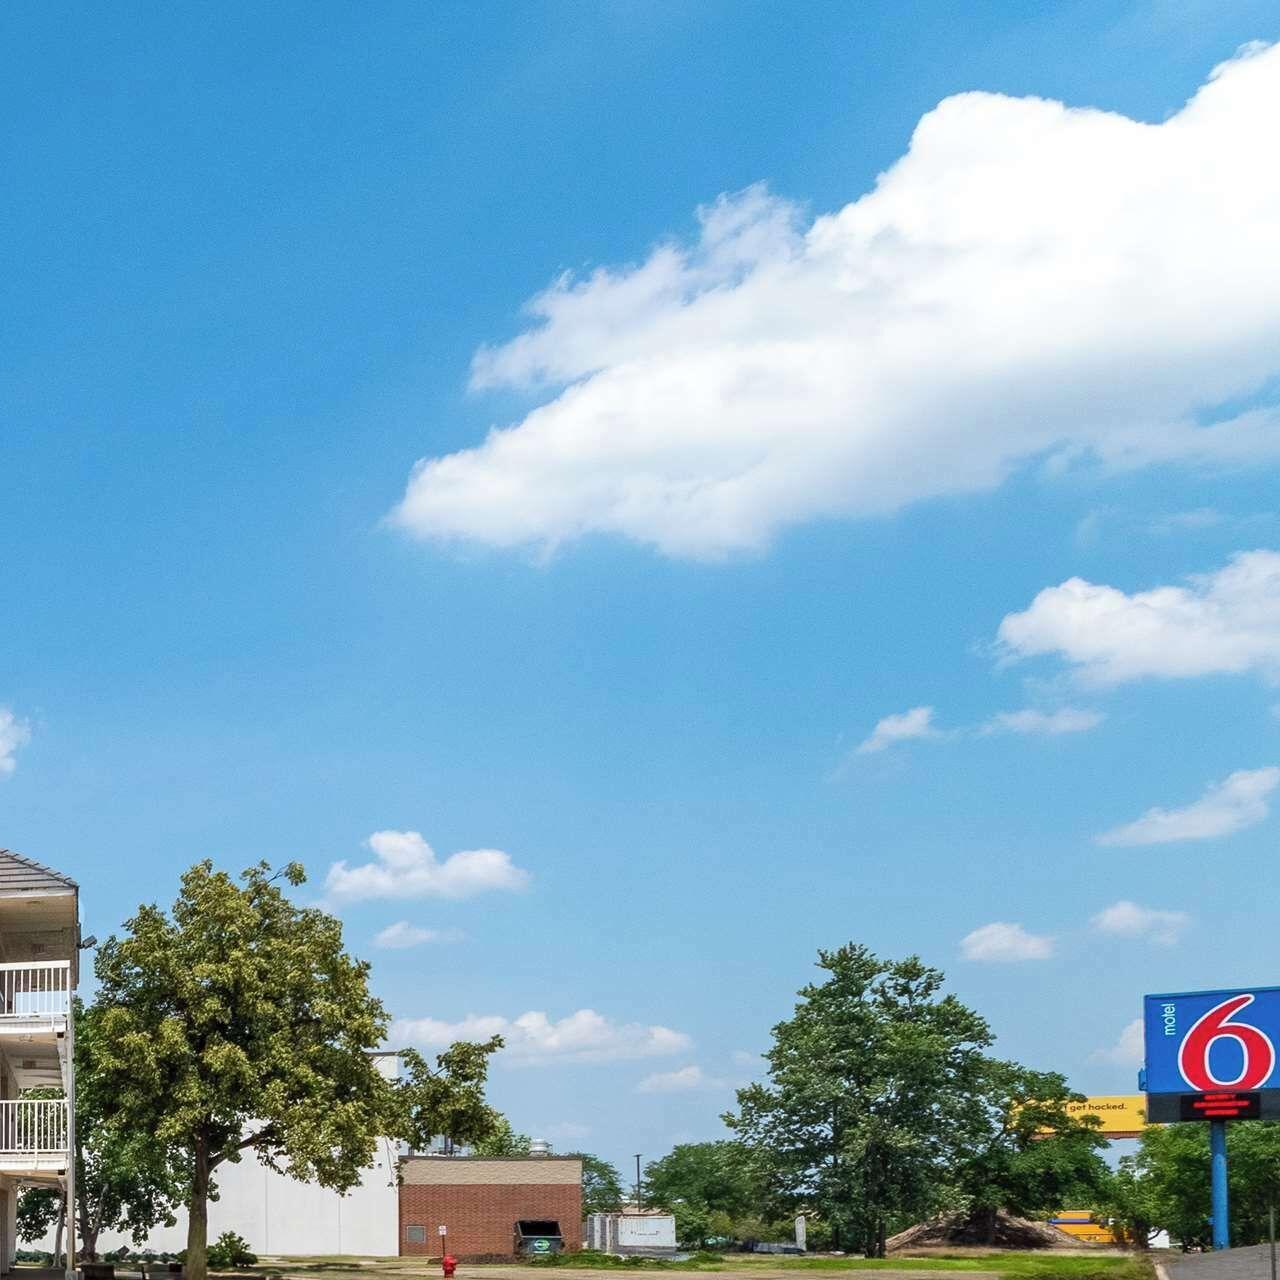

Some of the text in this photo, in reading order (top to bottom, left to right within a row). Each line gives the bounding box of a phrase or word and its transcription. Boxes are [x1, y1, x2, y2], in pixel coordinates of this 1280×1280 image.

[1161, 1003, 1176, 1036] motel
[1178, 993, 1276, 1091] 6
[1069, 1104, 1086, 1113] get
